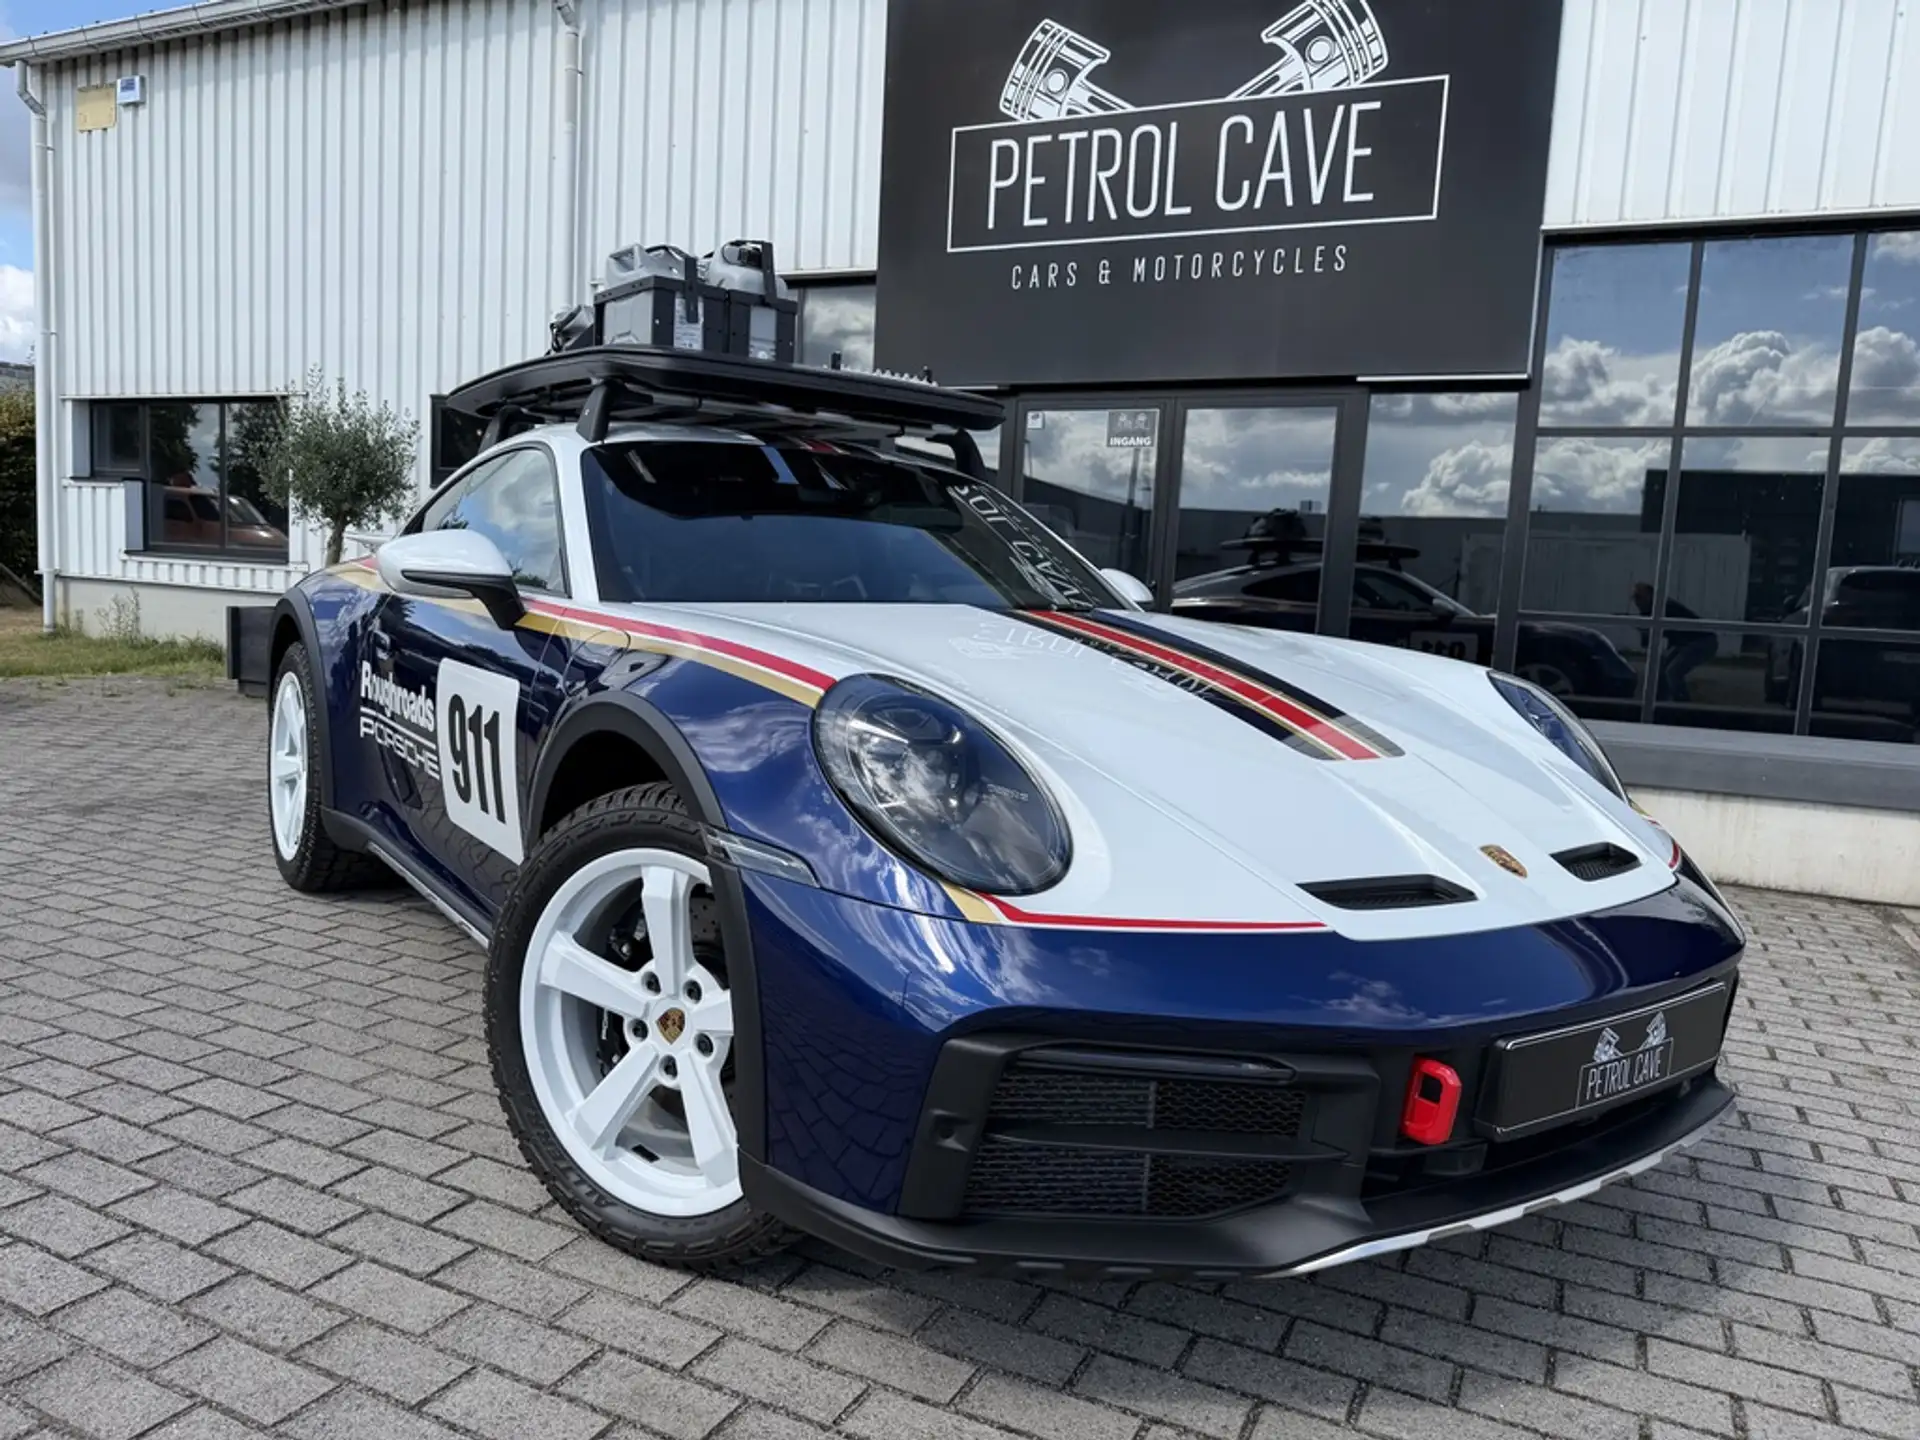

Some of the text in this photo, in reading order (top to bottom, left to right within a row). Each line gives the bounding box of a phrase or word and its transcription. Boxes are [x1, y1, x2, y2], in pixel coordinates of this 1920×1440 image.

[987, 101, 1382, 230] PETROL CAVE
[1011, 245, 1349, 290] CARS & MOTORCYCLES
[1109, 435, 1152, 447] INGANG
[360, 659, 436, 733] Roughroads
[360, 715, 441, 781] PORSCHE
[447, 693, 507, 825] 911
[1586, 1045, 1665, 1101] PETROL CAVE
